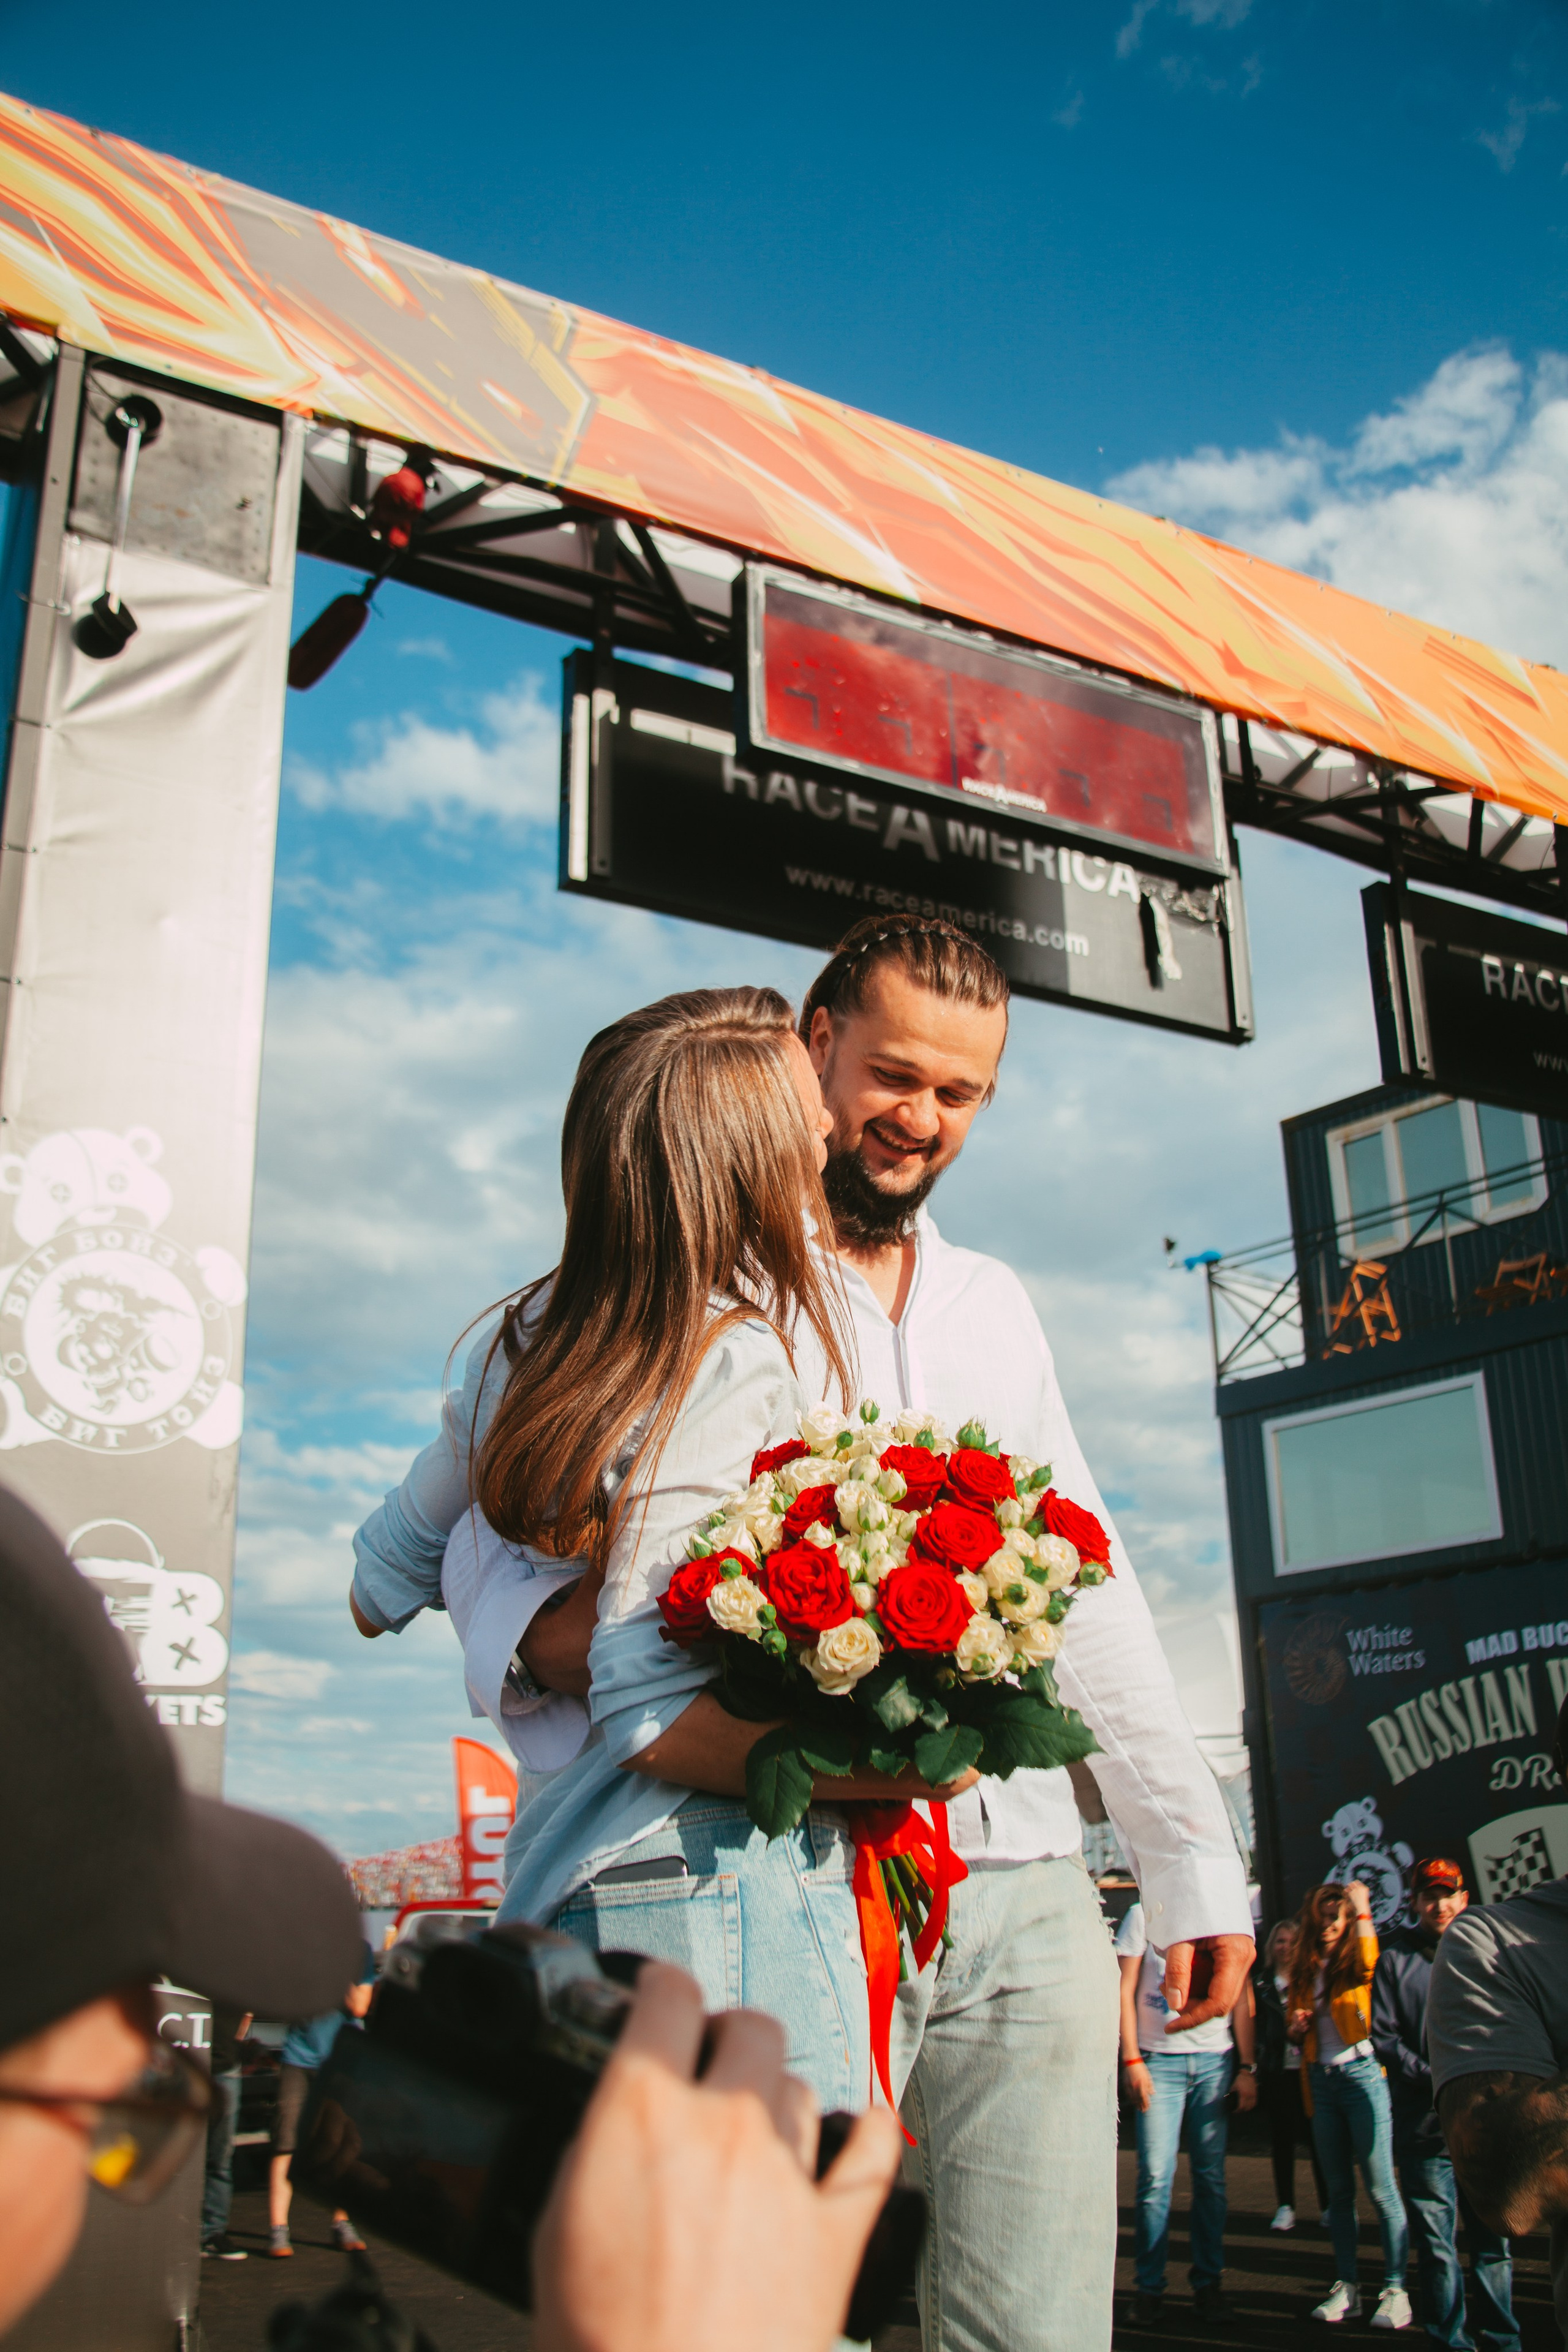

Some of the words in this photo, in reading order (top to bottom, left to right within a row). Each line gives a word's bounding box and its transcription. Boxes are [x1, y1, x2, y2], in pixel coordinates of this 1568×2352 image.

[784, 863, 1090, 957] www.raceamerica.com
[1346, 1623, 1414, 1654] White
[1464, 1629, 1520, 1665] MAD
[1348, 1648, 1427, 1678] Waters
[145, 1693, 227, 1727] ETS
[1366, 1663, 1539, 1786] RUSSIAN
